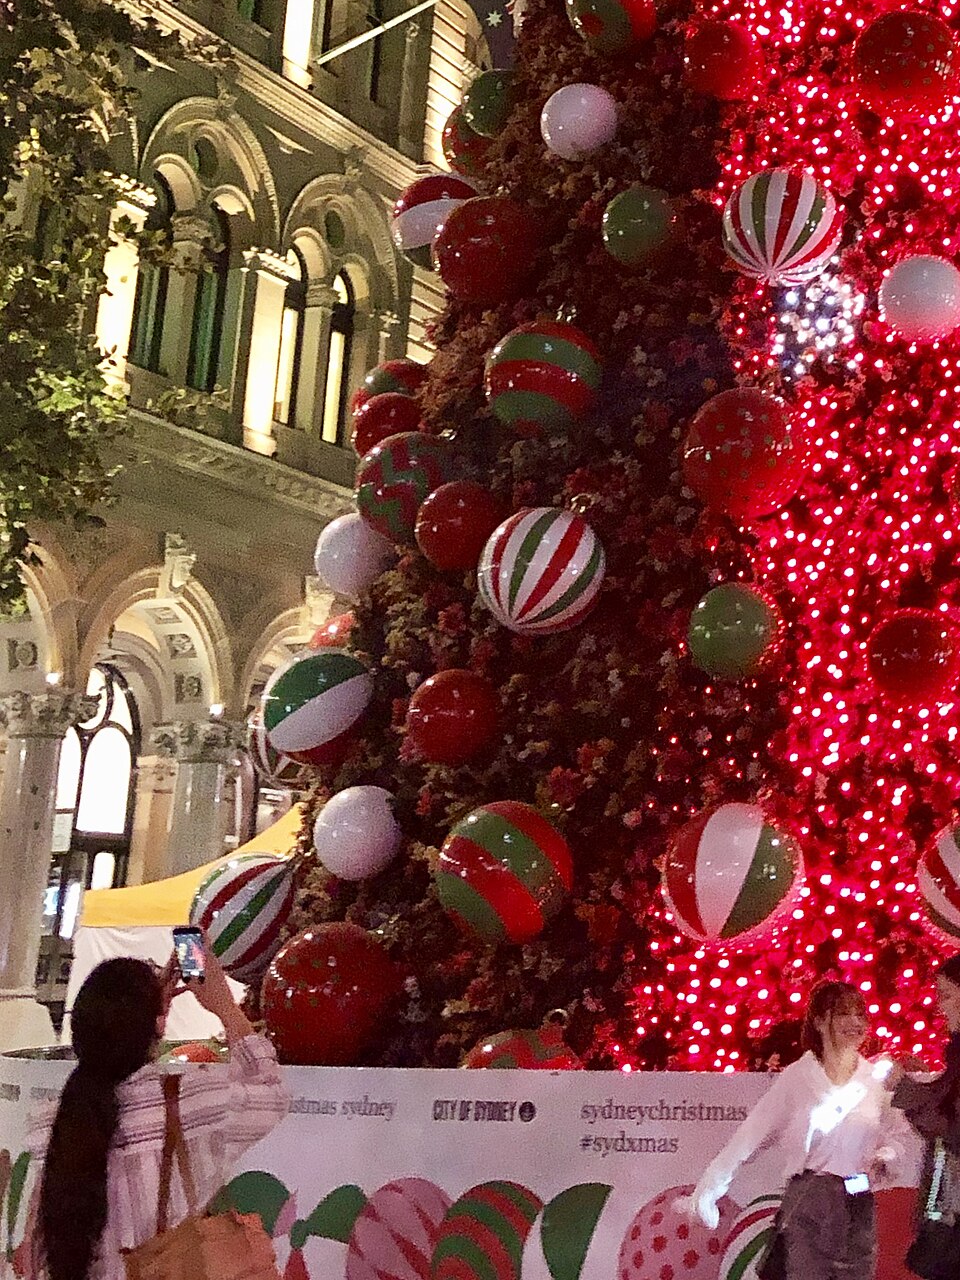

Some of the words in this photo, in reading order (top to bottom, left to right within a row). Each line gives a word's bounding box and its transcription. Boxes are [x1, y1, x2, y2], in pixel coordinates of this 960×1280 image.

[341, 1094, 397, 1121] sydney
[433, 1099, 457, 1121] CITY
[459, 1100, 473, 1121] OF
[474, 1100, 517, 1122] SYDNEY
[580, 1099, 749, 1125] sydneychristmas
[579, 1130, 680, 1158] #sydxmas
